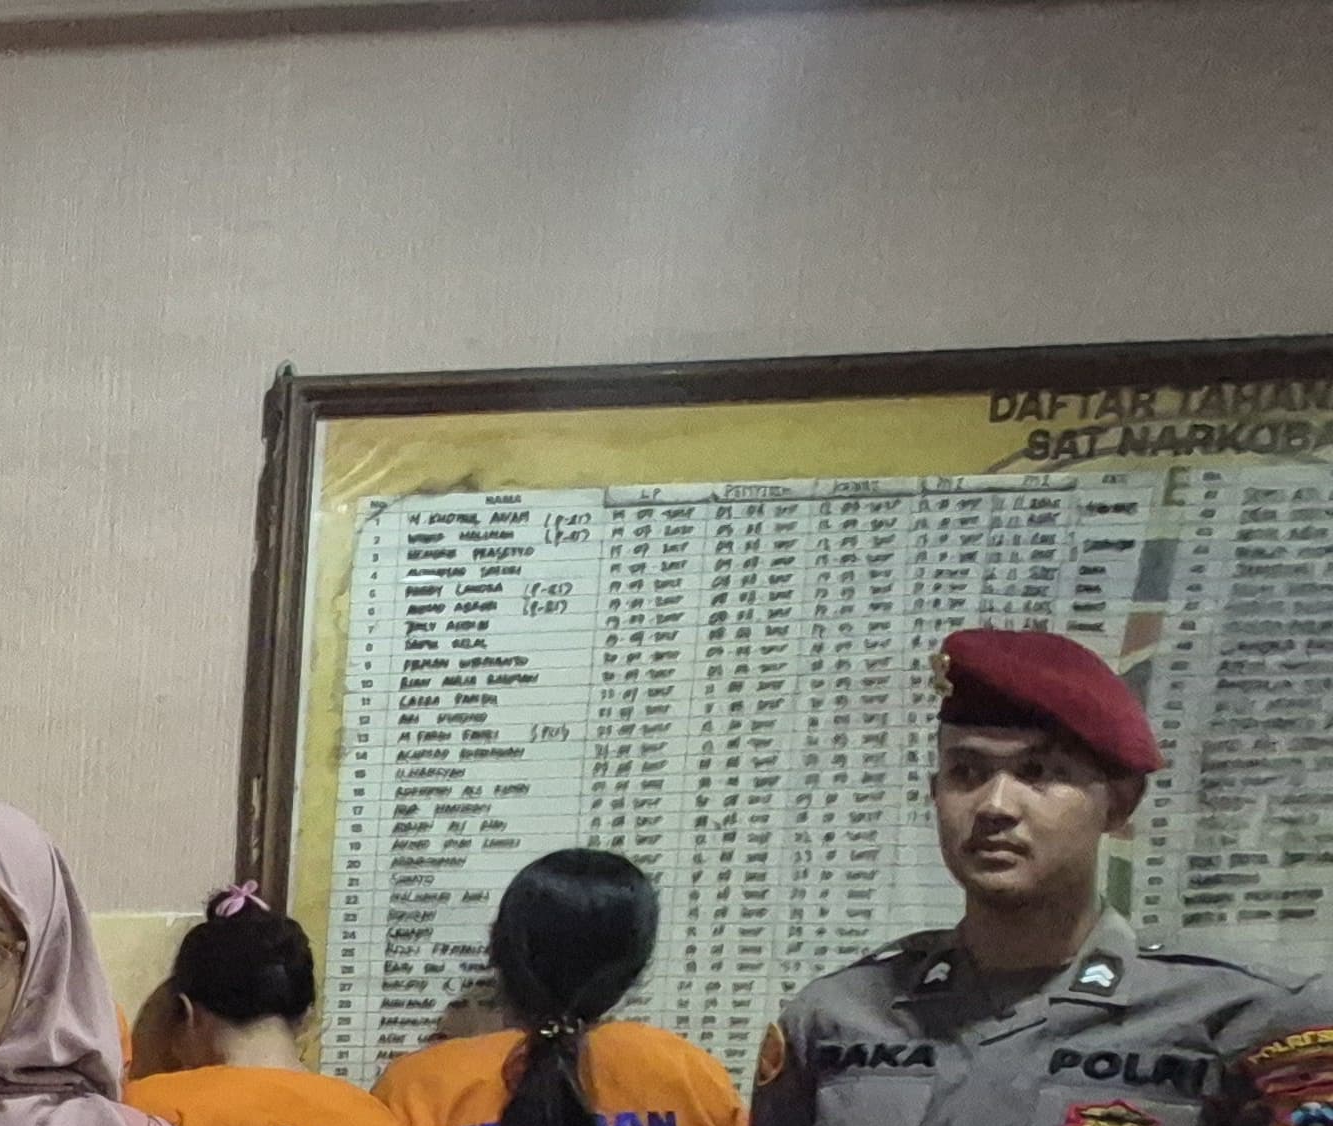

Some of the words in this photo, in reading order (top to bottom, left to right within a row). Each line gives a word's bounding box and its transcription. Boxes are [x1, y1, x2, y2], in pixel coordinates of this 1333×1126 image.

[988, 388, 1156, 423] DAFTAR
[1171, 383, 1333, 418] TAHAN
[1026, 426, 1105, 461] SAT
[373, 536, 381, 545] 2
[370, 571, 378, 581] 4
[352, 805, 364, 815] 17
[1048, 1048, 1211, 1098] POLRI
